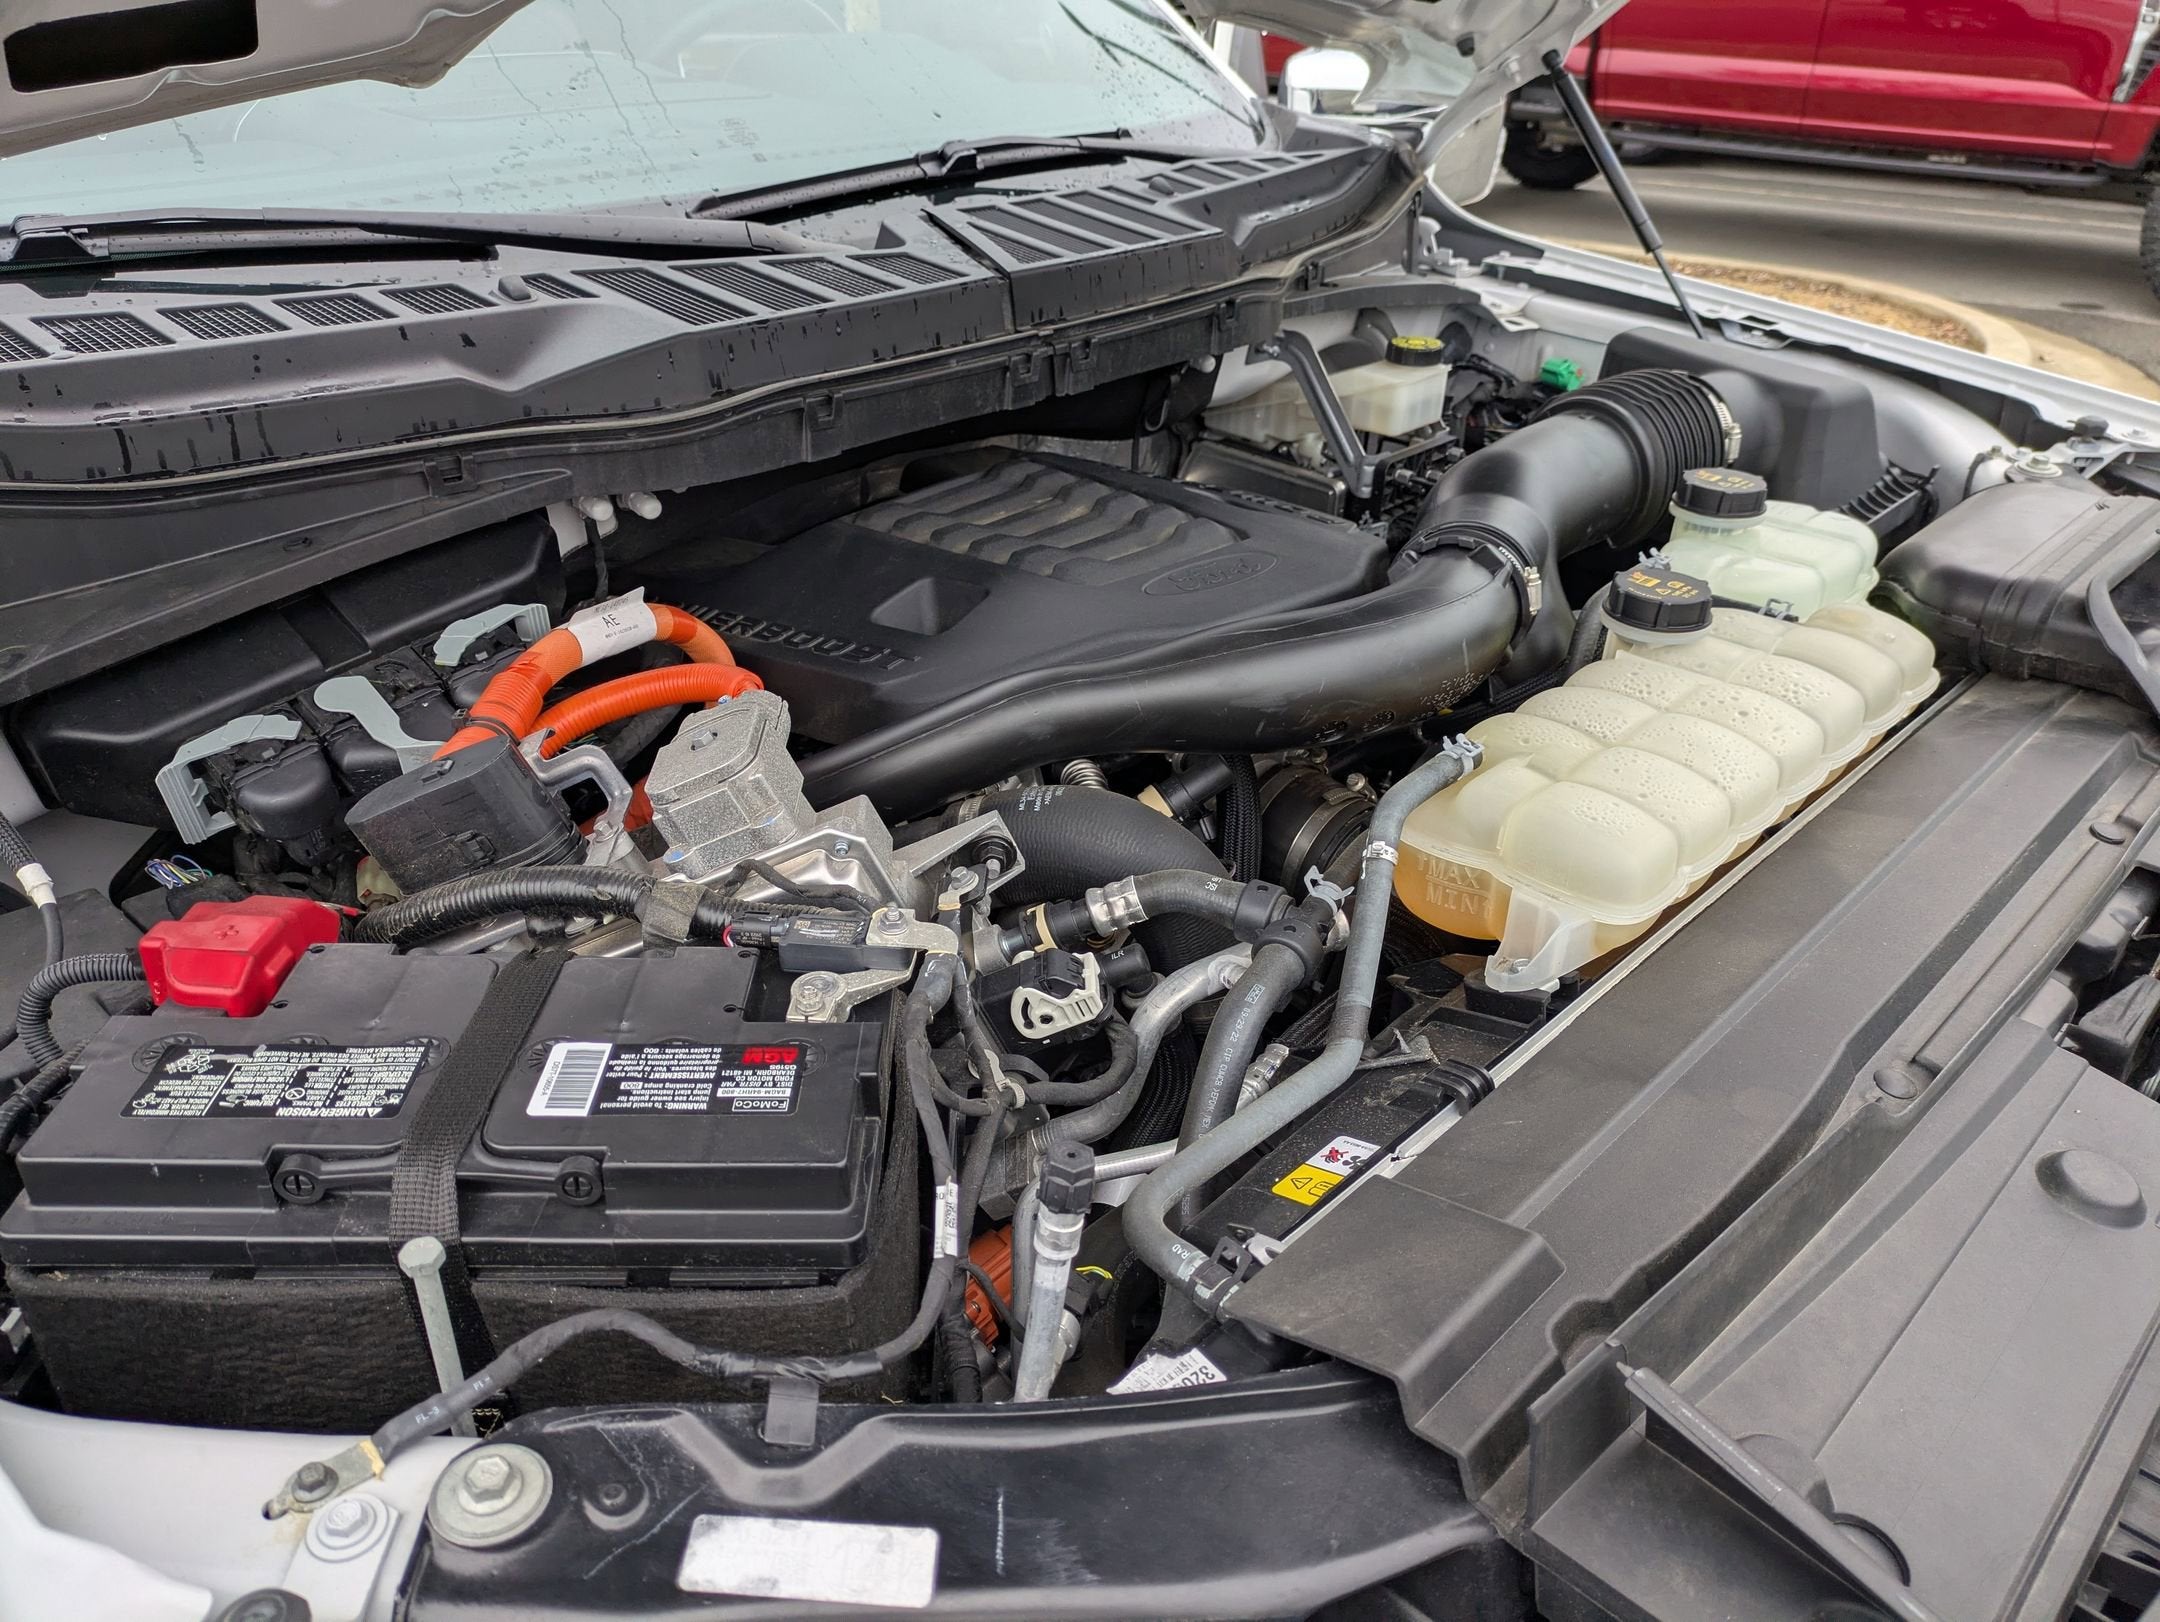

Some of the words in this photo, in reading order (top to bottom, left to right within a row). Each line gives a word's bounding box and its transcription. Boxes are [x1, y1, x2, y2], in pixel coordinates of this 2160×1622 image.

[1428, 857, 1480, 889] MAX
[1426, 882, 1477, 914] MIN
[742, 1047, 799, 1064] AGM
[275, 1108, 366, 1117] DANGER/POISON
[664, 1102, 707, 1110] WARNING:
[735, 1100, 786, 1109] FoMoCo
[1172, 1365, 1215, 1388] 320
